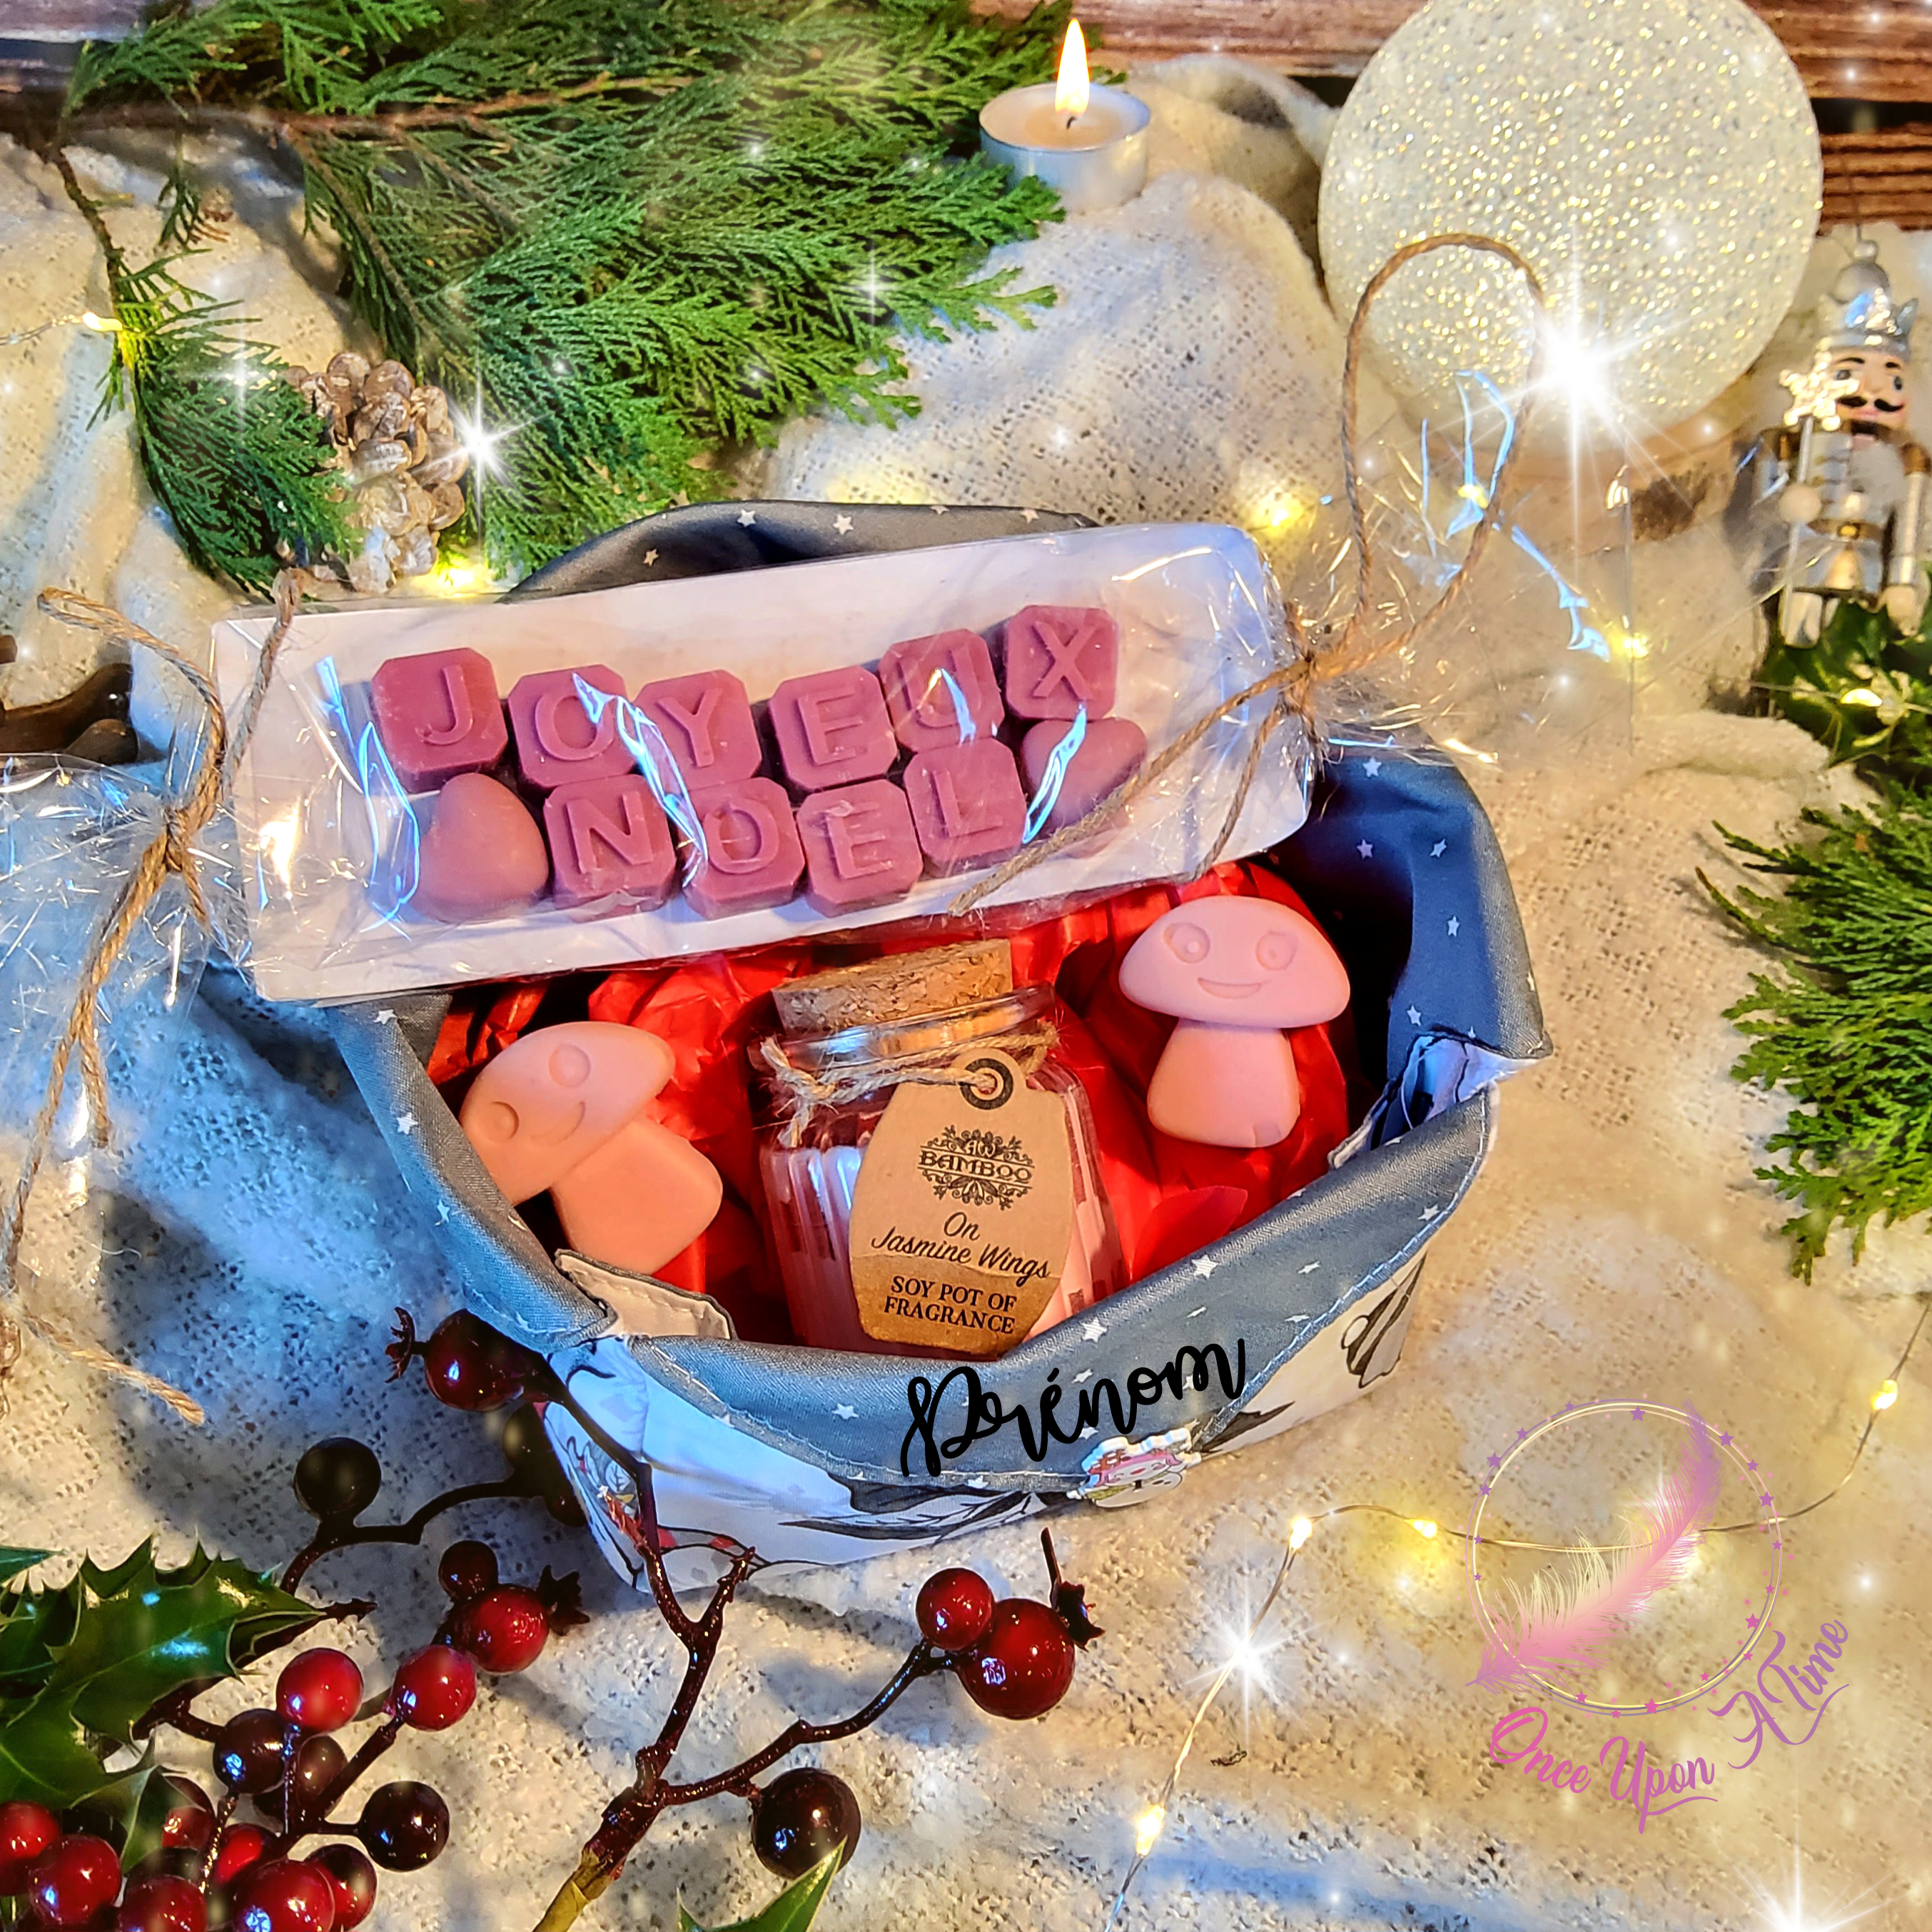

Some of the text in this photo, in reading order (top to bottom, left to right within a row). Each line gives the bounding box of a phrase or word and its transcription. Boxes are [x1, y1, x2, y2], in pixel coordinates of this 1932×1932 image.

[418, 620, 1099, 767] JOYEUX
[570, 770, 1003, 880] NOEL
[919, 1150, 1033, 1184] BAMBOO
[944, 1211, 980, 1241] On
[871, 1227, 1051, 1288] Jasmine Wings
[891, 1276, 1017, 1313] SOY POT OF
[884, 1295, 1016, 1335] FRAGRANCE
